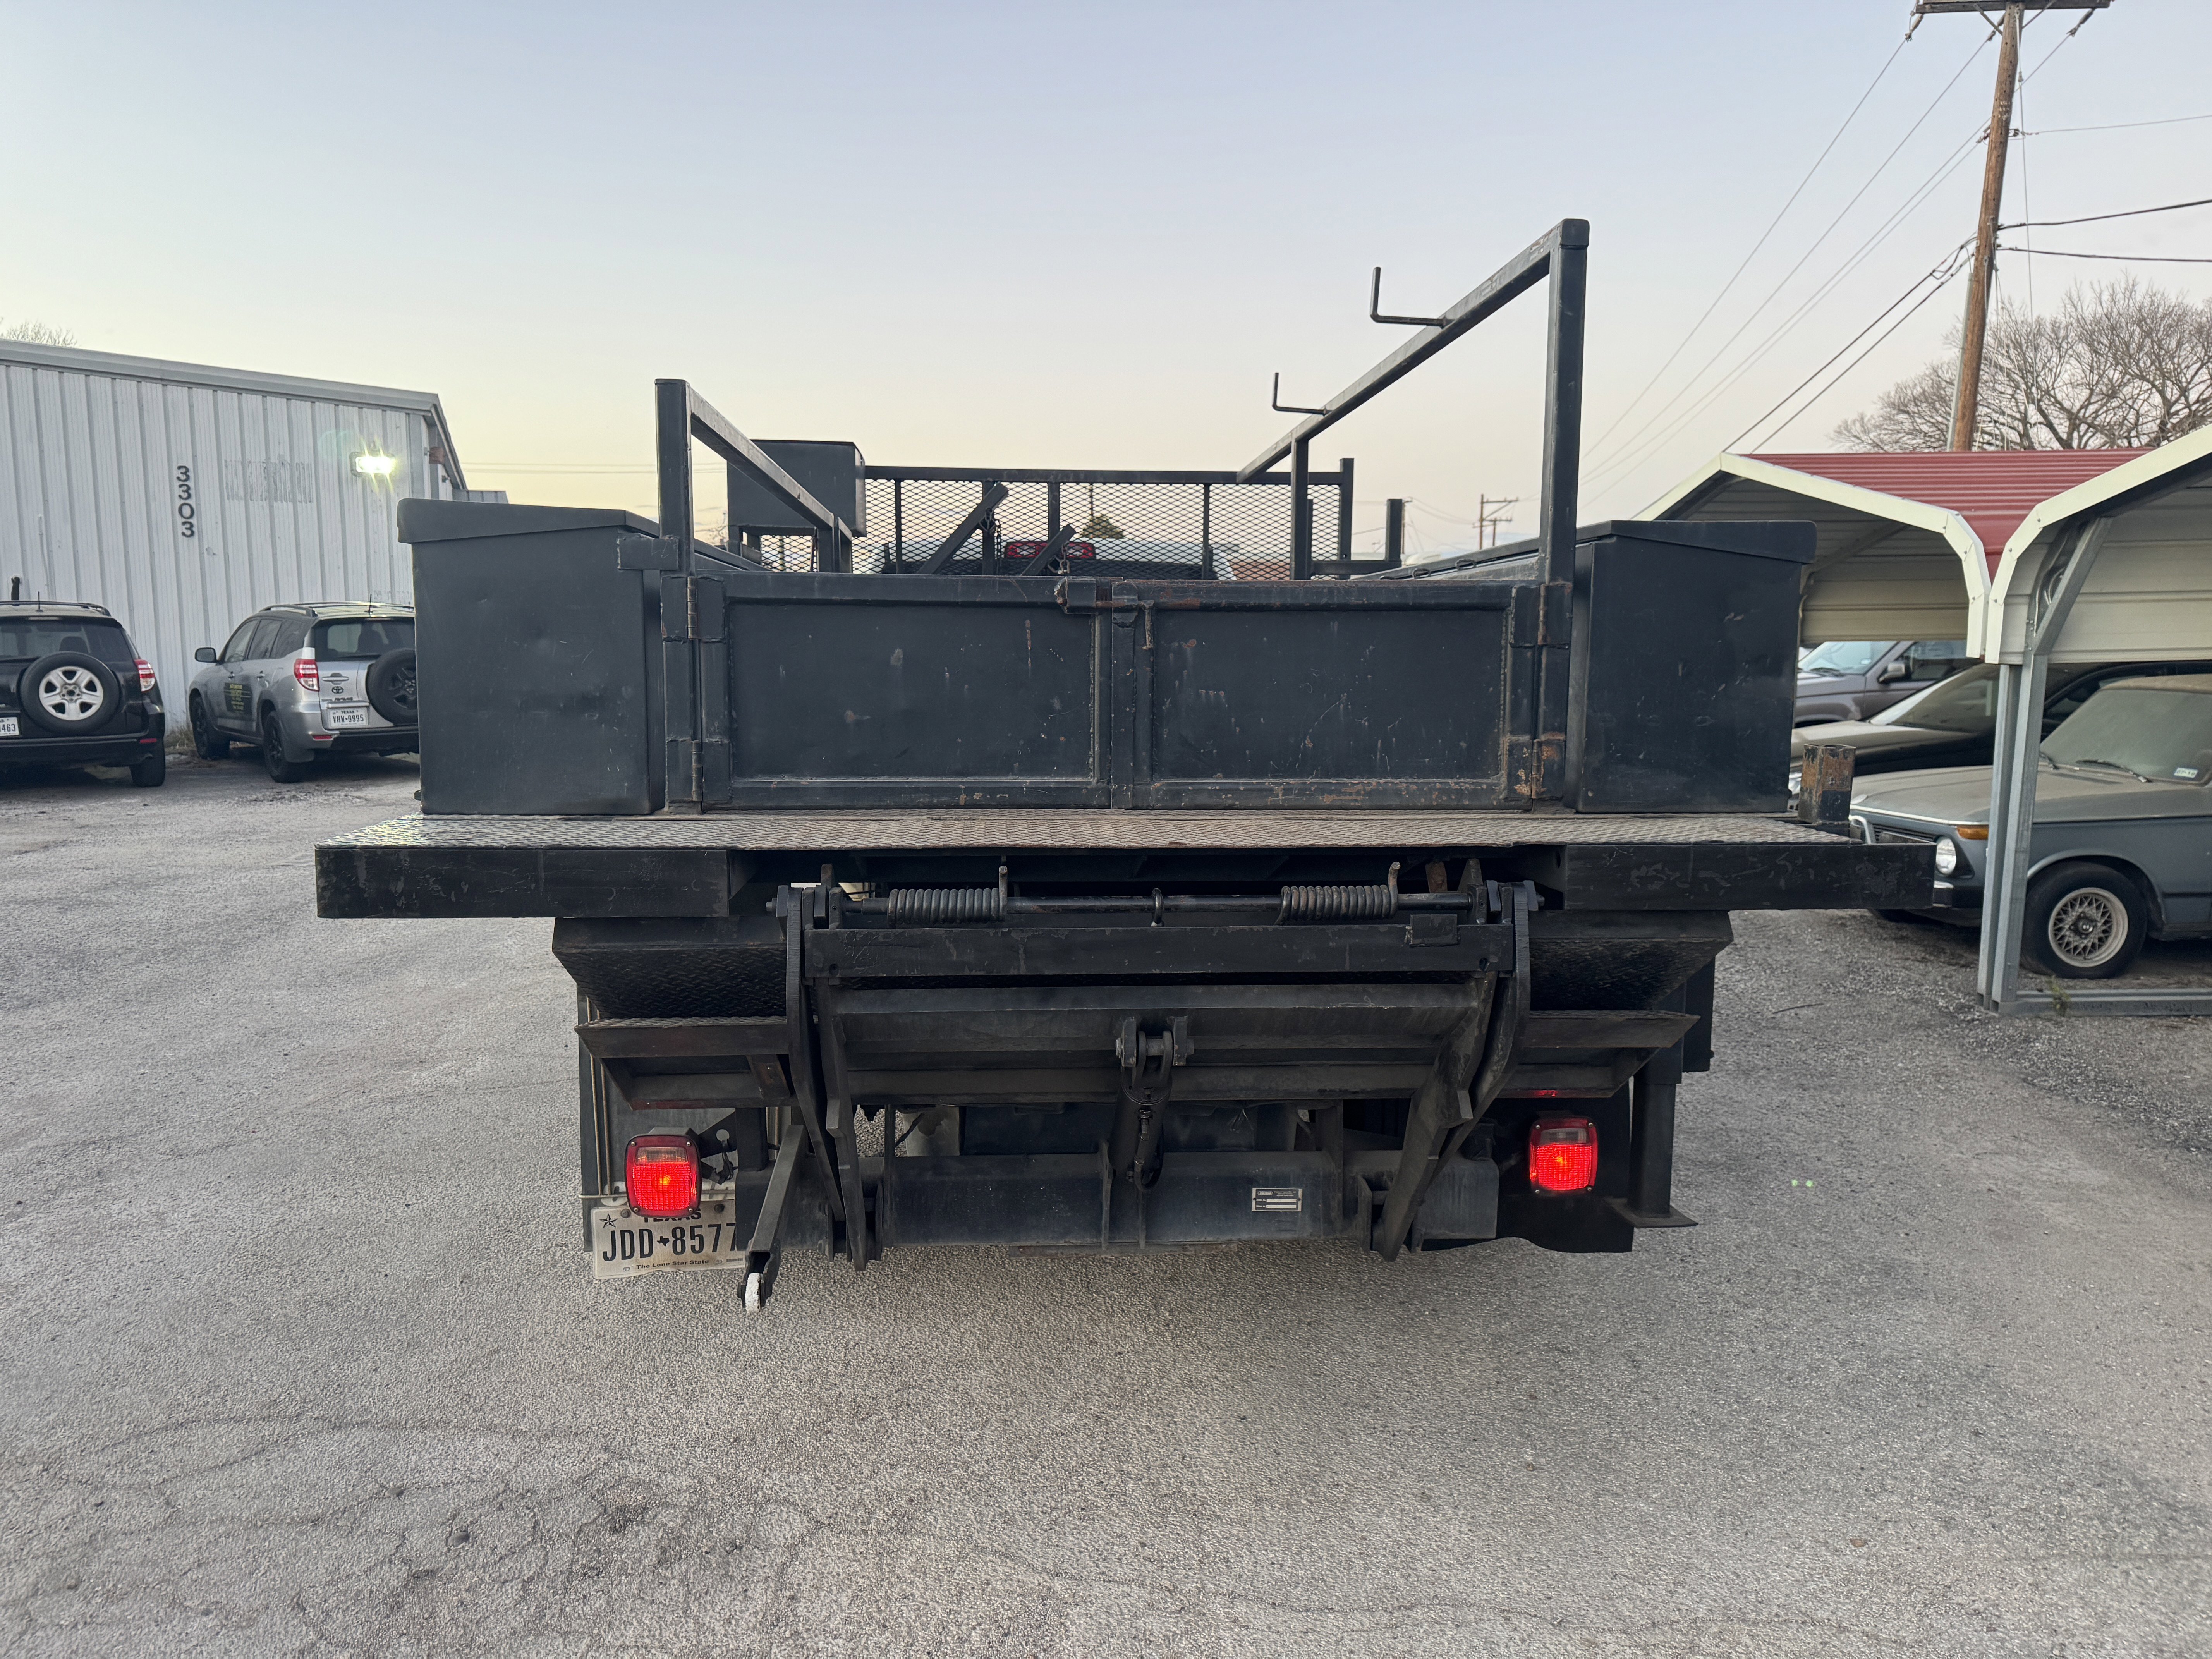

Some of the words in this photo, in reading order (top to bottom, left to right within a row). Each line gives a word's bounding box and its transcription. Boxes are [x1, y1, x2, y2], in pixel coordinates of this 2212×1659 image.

[177, 465, 194, 538] 3303
[0, 723, 16, 732] 463
[348, 714, 364, 722] 9995
[603, 1229, 653, 1262] JDD
[672, 1223, 735, 1255] 8577
